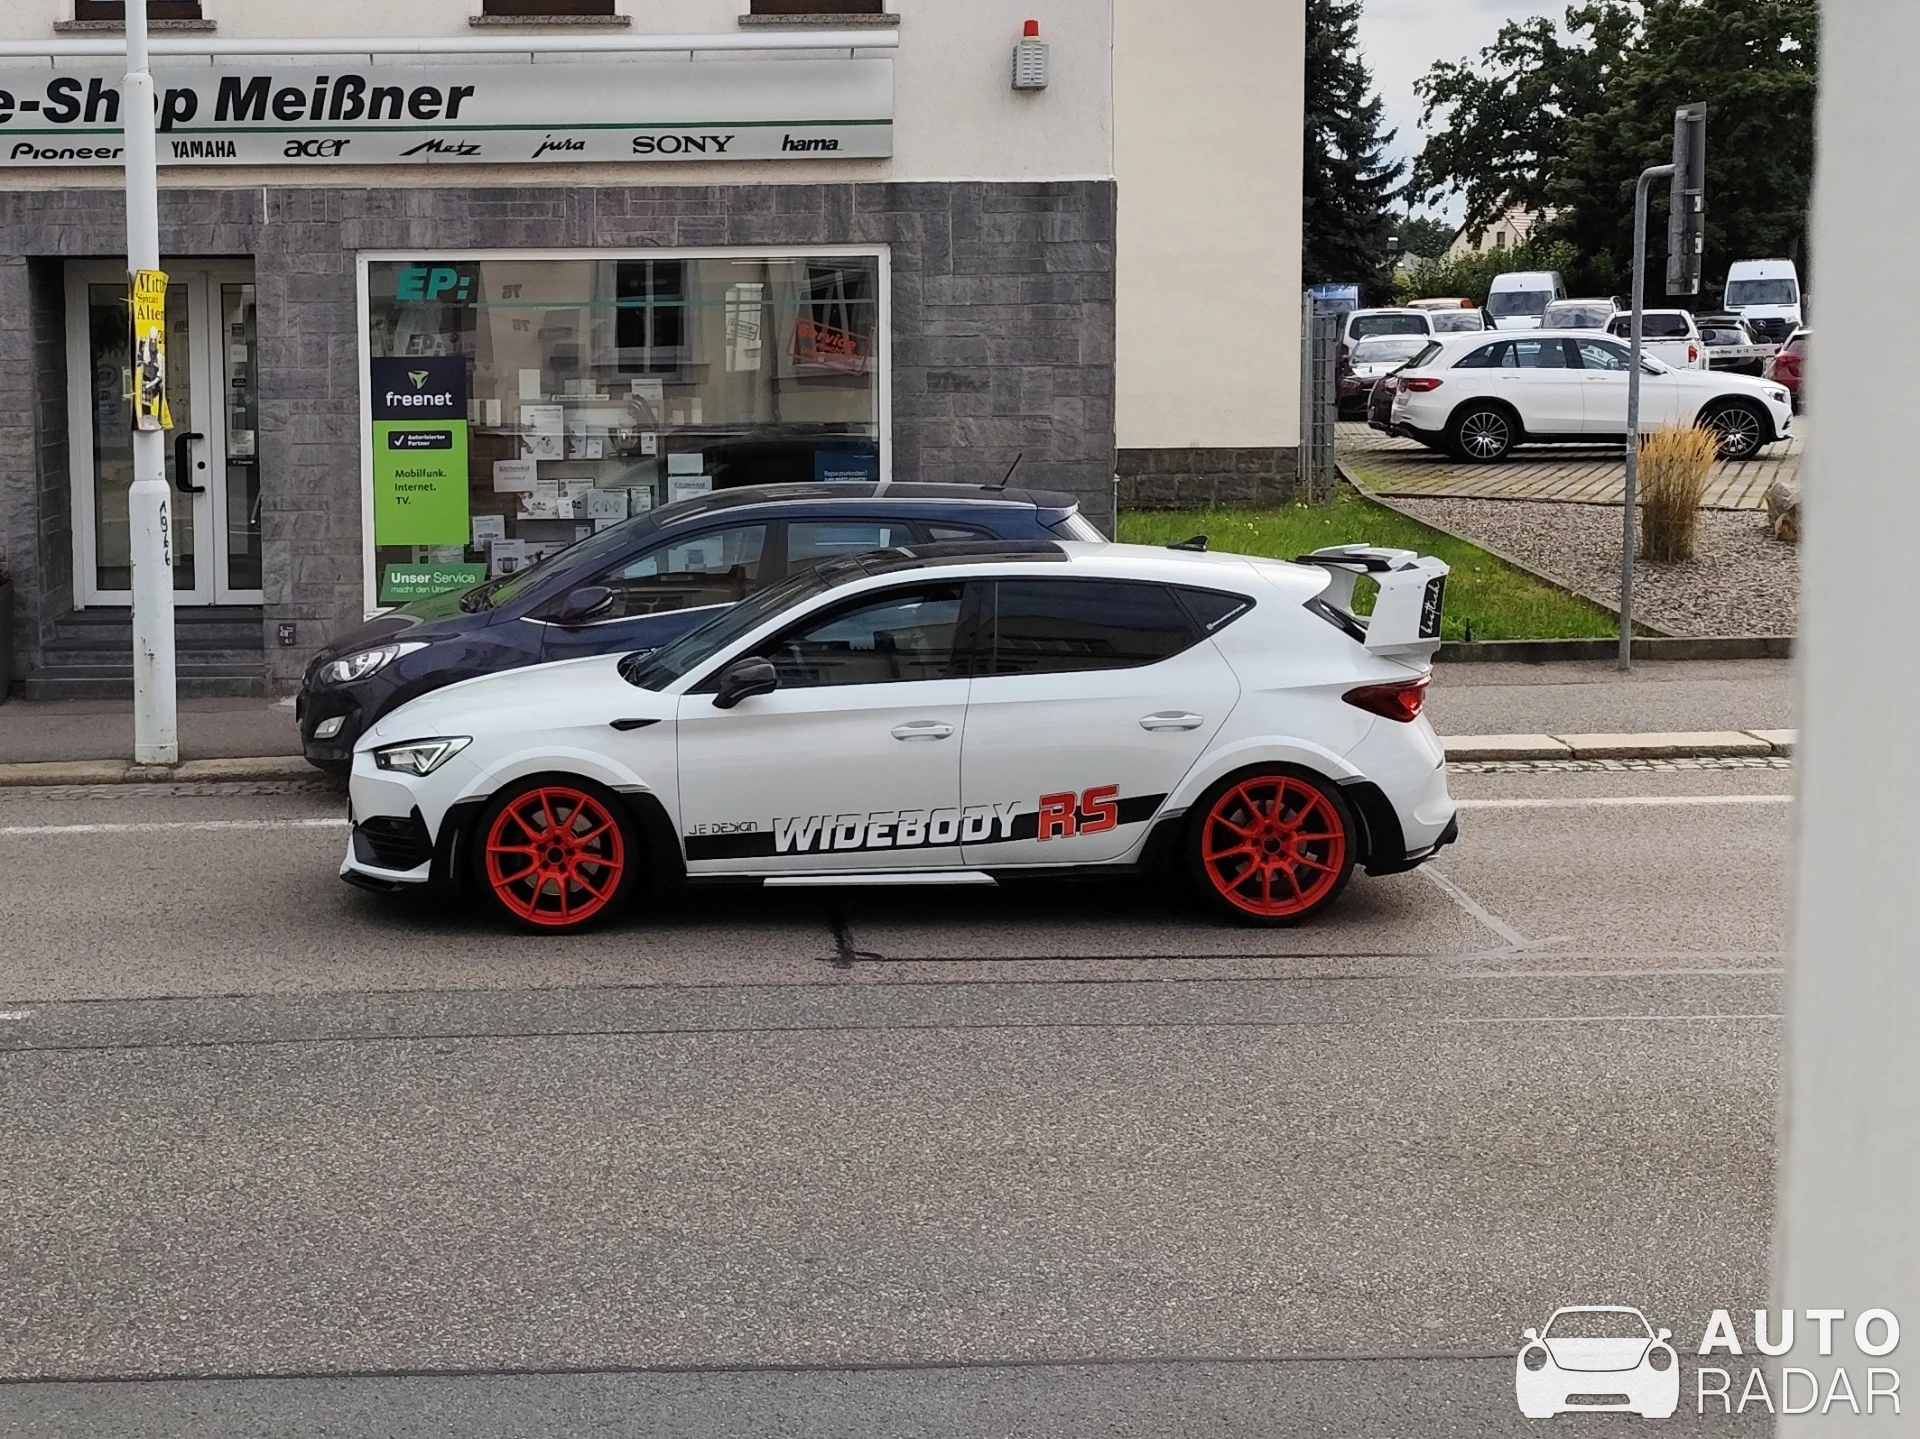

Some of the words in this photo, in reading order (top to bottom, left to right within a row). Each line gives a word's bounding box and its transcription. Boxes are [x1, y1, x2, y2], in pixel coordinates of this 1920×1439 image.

[0, 77, 198, 132] -Shp
[214, 75, 475, 121] Meißner
[10, 143, 124, 160] Pioneer
[171, 140, 237, 159] YAMAHA
[283, 138, 350, 158] acer
[399, 137, 482, 156] Metz
[532, 134, 585, 159] jura
[632, 134, 735, 154] SONY
[782, 134, 839, 152] hama
[396, 267, 470, 301] EP:
[385, 391, 453, 407] freenet
[395, 468, 447, 478] Mobilfunk.
[394, 483, 437, 492] Internet.
[396, 496, 412, 505] TV.
[391, 572, 431, 584] Unser
[433, 571, 476, 584] Service
[688, 824, 707, 835] JE
[772, 801, 1021, 853] WIDEBODY
[1036, 784, 1120, 843] RS
